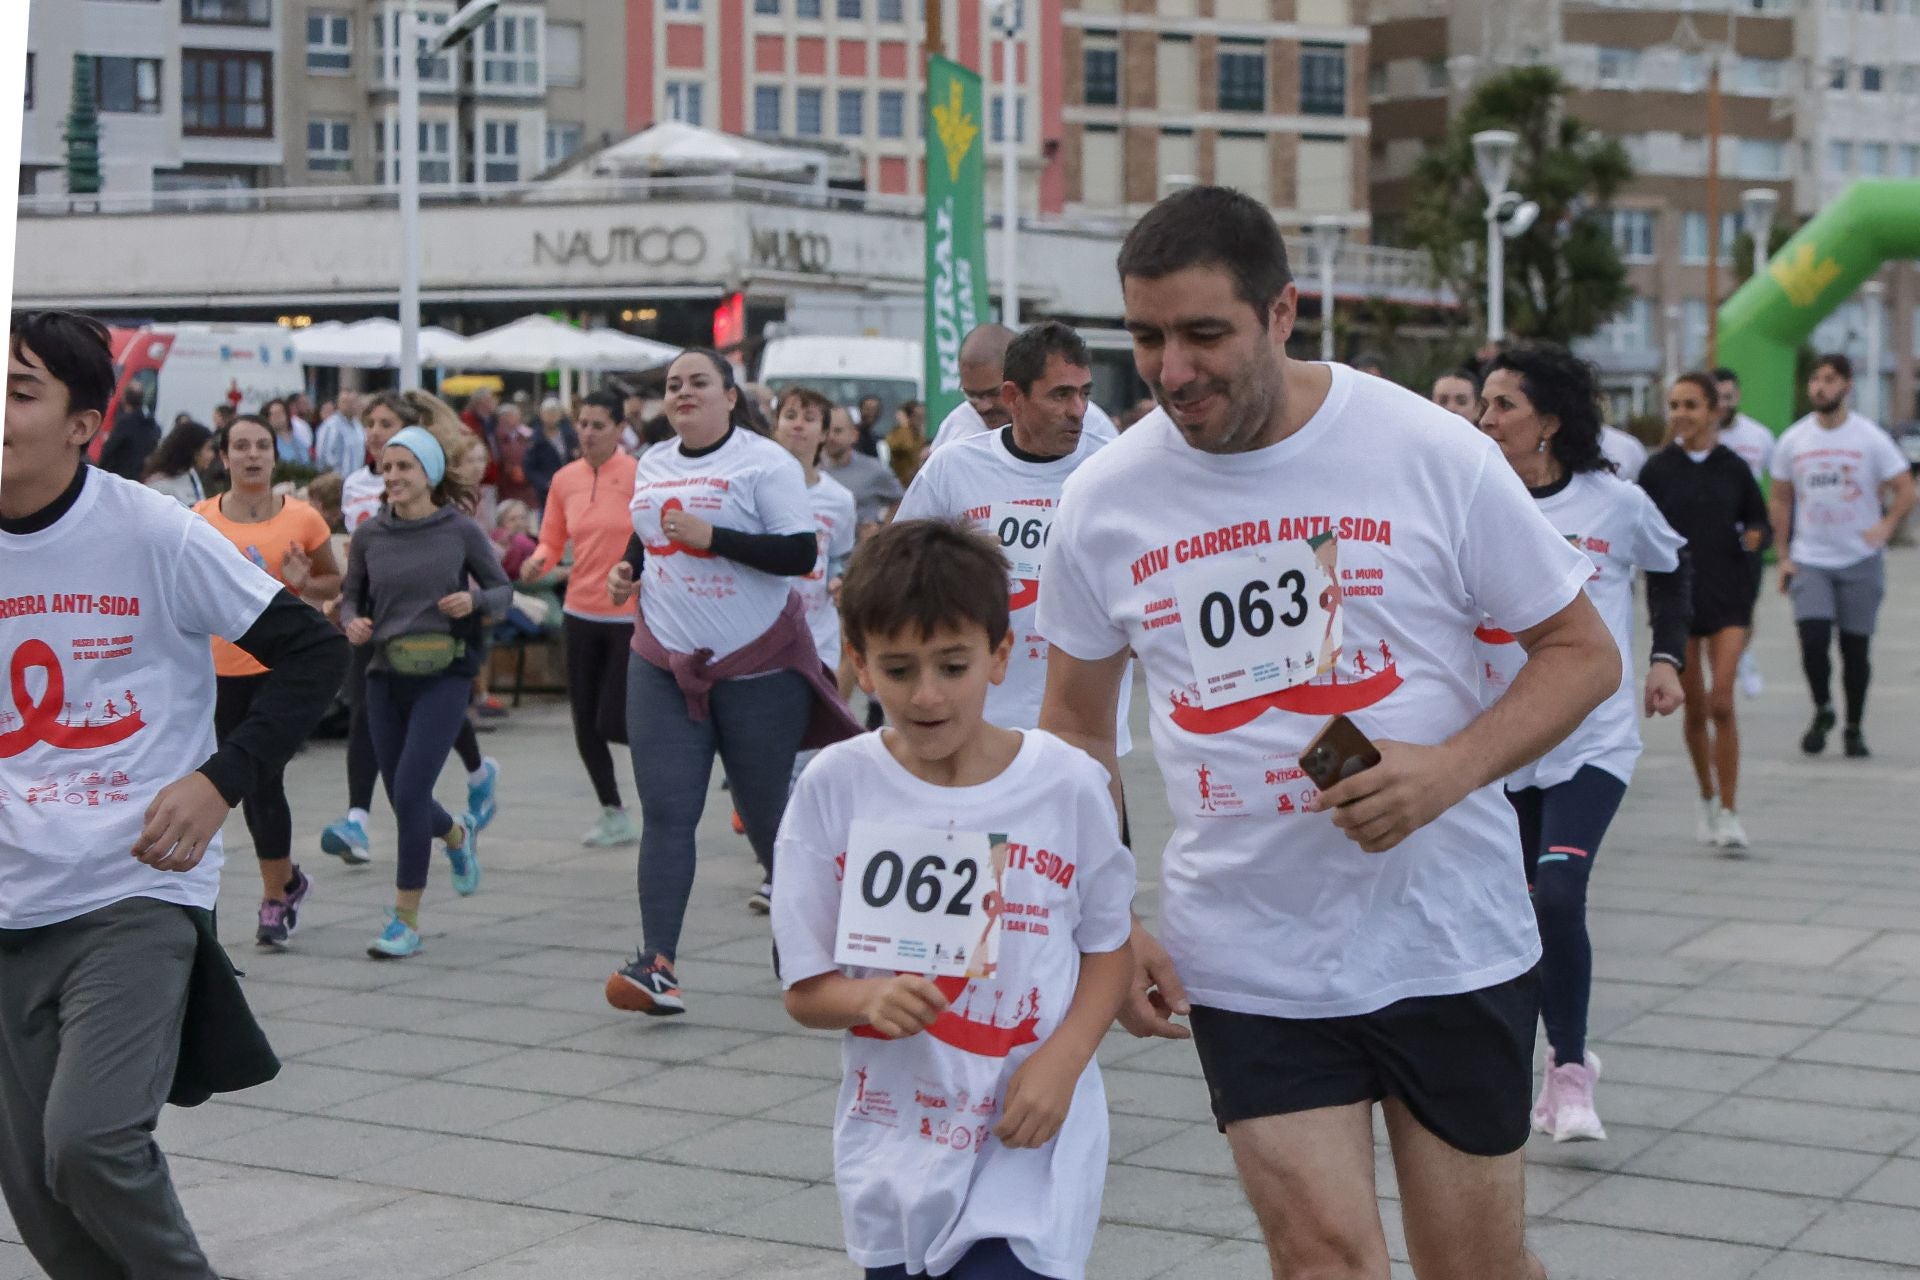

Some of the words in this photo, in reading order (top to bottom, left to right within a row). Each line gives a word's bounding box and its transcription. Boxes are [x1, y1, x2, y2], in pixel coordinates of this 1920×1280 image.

[934, 196, 961, 394] RURAL
[1130, 545, 1169, 586] XXIV
[1174, 519, 1272, 564] CARRERA
[1355, 568, 1384, 580] MURO
[51, 593, 140, 617] ANTI-SIDA
[1199, 569, 1309, 649] 063
[1343, 585, 1384, 597] LORENZO
[861, 850, 979, 917] 062
